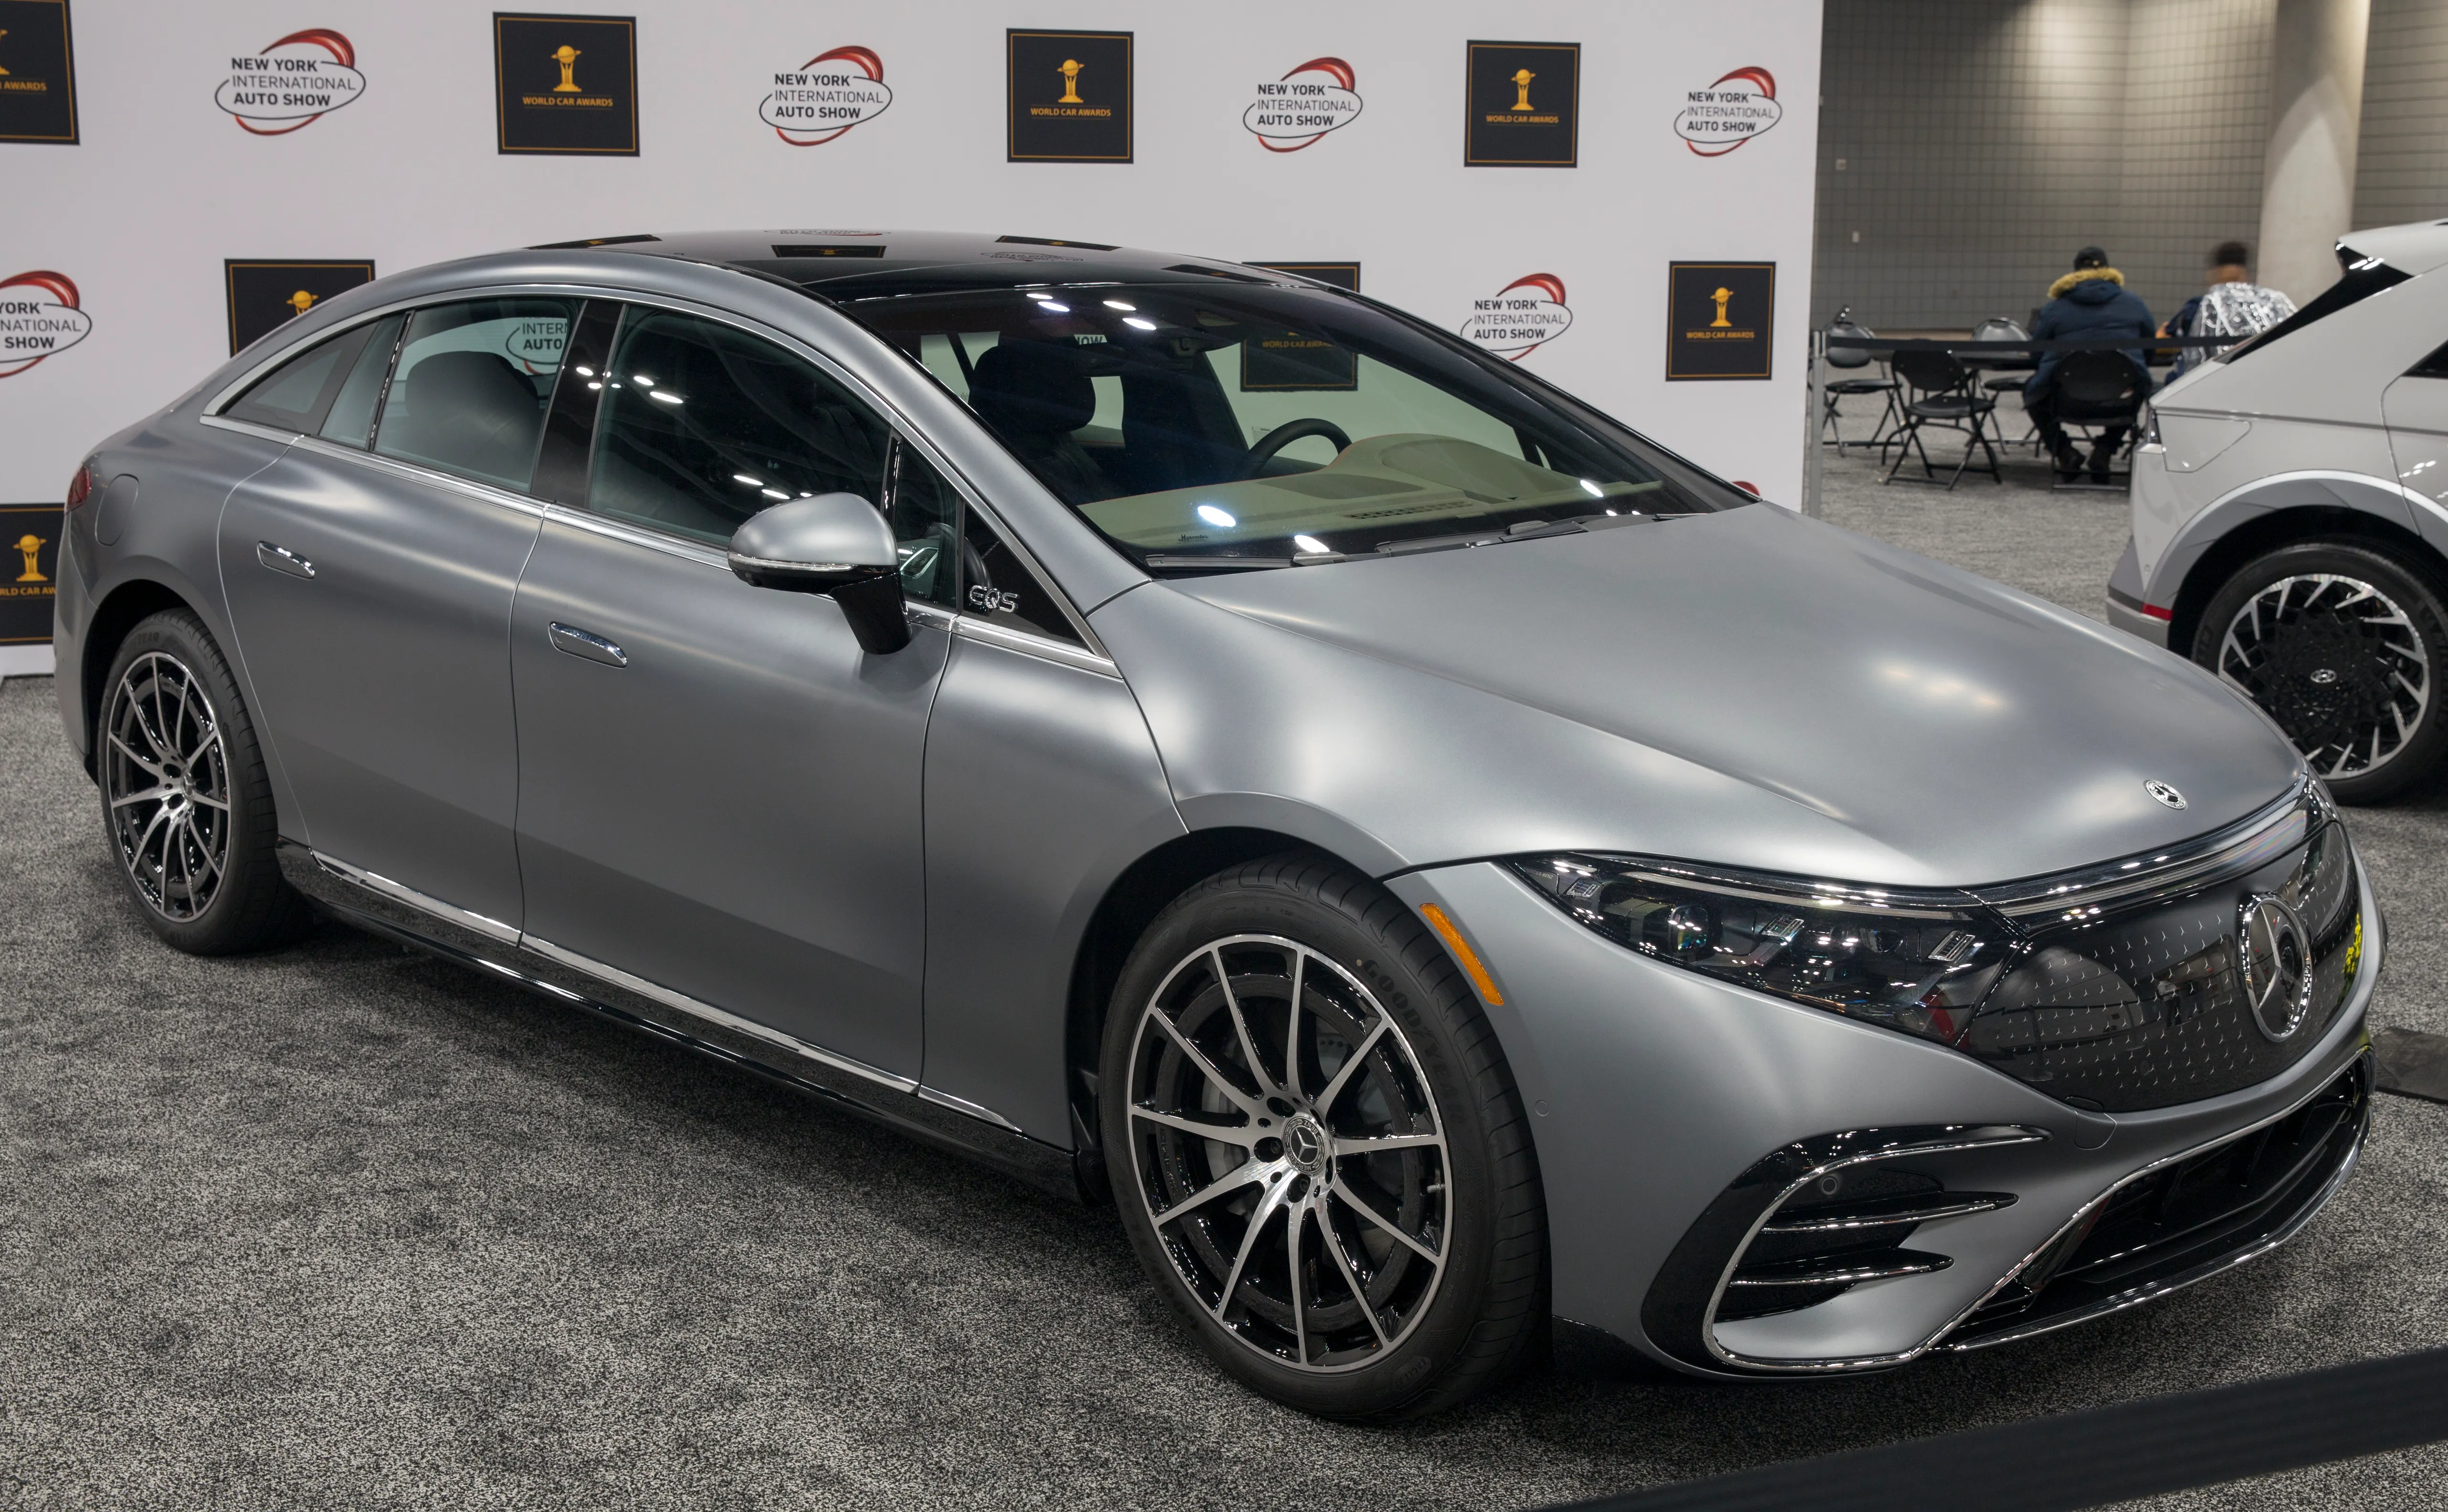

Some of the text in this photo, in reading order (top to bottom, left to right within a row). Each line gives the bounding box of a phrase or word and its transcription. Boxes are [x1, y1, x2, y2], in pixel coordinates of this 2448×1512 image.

[232, 57, 317, 72] NEW YORK
[4, 81, 47, 91] AWARDS
[232, 75, 356, 90] INTERNATIONAL
[775, 74, 850, 86] NEW YORK
[1258, 84, 1325, 95] NEW YORK
[234, 92, 330, 106] AUTO SHOW
[522, 97, 555, 105] WORLD
[576, 98, 613, 106] AWARDS
[775, 90, 883, 103] INTERNATIONAL
[1688, 92, 1749, 103] NEW YORK
[1258, 99, 1354, 111] INTERNATIONAL
[775, 106, 861, 118] AUTO SHOW
[1687, 106, 1775, 118] INTERNATIONAL
[1257, 115, 1334, 126] AUTO SHOW
[1687, 121, 1756, 132] AUTO SHOW
[1475, 300, 1538, 310] NEW YORK
[1474, 315, 1565, 325] INTERNATIONAL
[1474, 329, 1546, 339] AUTO SHOW
[5, 336, 55, 348] SHOW
[524, 338, 562, 350] AUTO
[20, 587, 40, 595] CAR
[969, 585, 1020, 613] EQS
[1304, 1120, 1318, 1134] BENZ
[1287, 1147, 1312, 1171] MERCEDES
